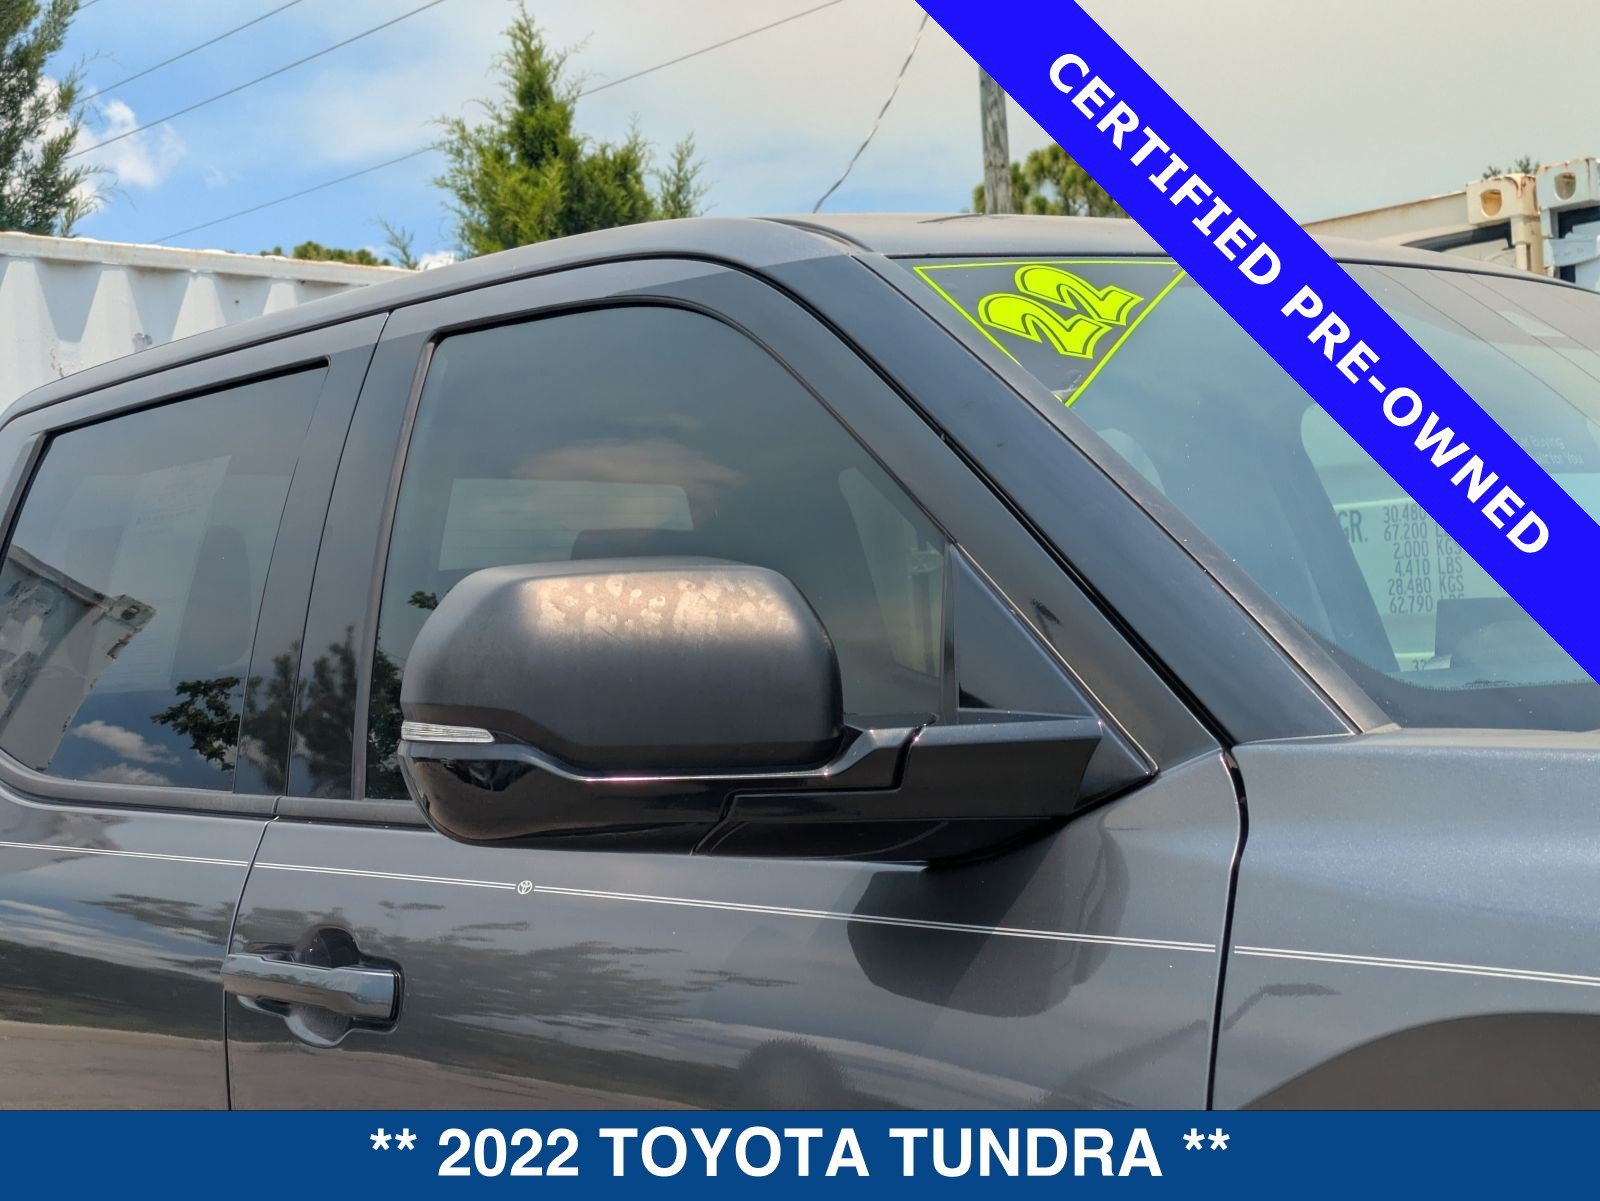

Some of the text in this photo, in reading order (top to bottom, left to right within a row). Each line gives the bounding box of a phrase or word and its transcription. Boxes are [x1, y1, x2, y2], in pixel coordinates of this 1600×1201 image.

[978, 265, 1145, 360] 22
[1384, 521, 1428, 541] 67.200
[1393, 540, 1429, 560] 2.000
[1438, 556, 1463, 575] LBS
[1388, 575, 1465, 596] 28.480 KGS
